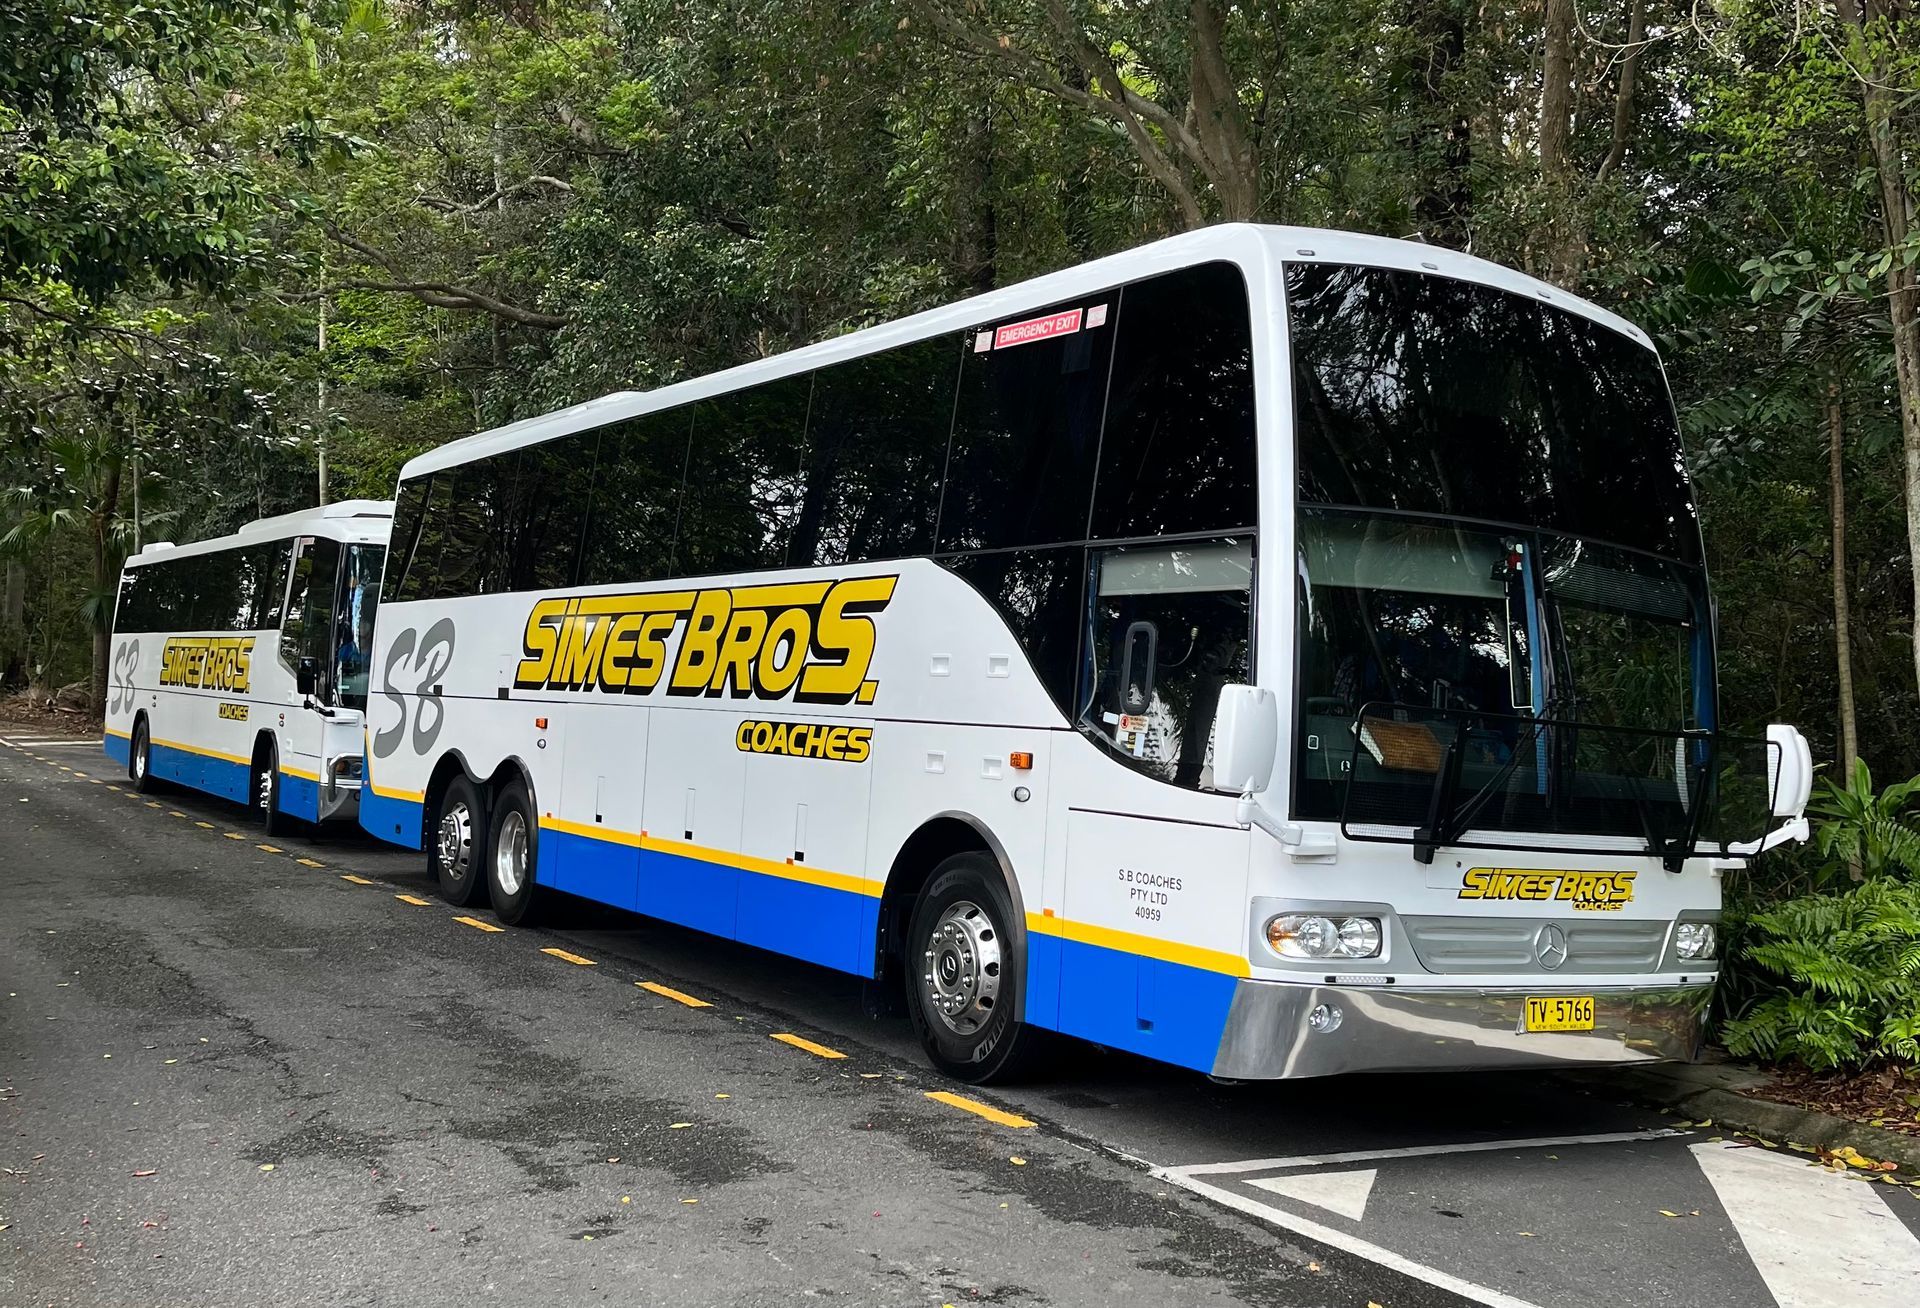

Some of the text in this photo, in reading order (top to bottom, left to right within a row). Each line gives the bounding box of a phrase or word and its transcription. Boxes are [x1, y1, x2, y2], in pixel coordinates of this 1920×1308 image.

[1000, 315, 1077, 343] EMERGENCY EXIT
[219, 702, 249, 721] COACHES
[735, 719, 874, 763] COACHES
[1135, 872, 1182, 891] COACHES
[1130, 887, 1168, 905] PTY LTD
[1135, 906, 1161, 921] 40959
[1572, 901, 1624, 912] COACHES
